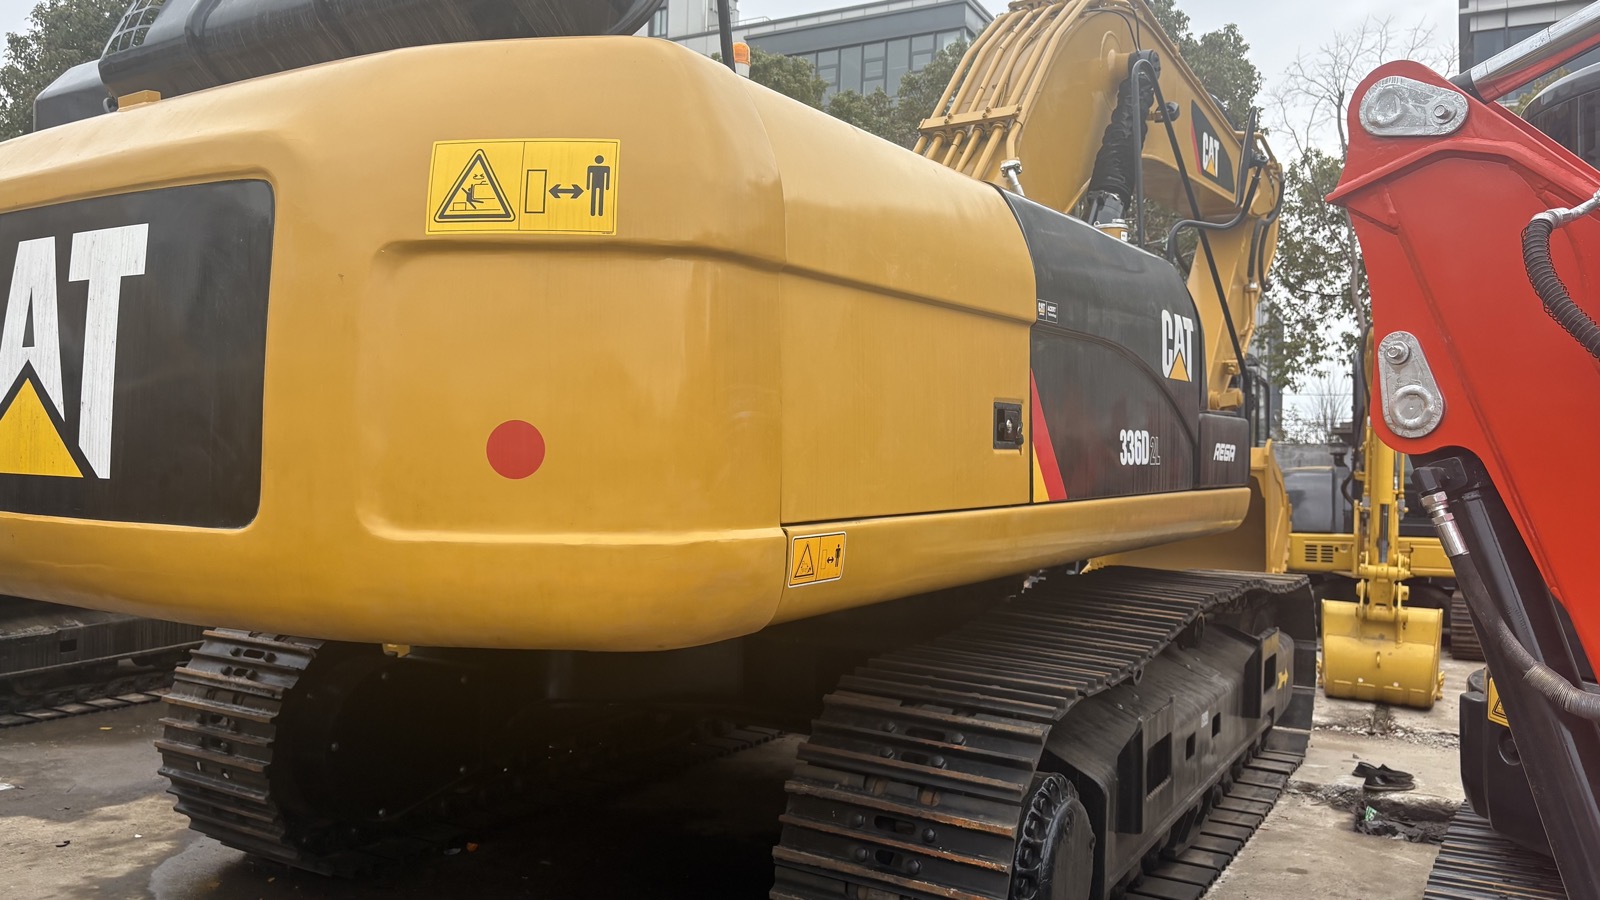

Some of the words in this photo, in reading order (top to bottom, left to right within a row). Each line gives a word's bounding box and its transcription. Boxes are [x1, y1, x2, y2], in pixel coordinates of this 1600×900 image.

[1202, 132, 1220, 178] CAT
[0, 222, 149, 479] AT
[1161, 309, 1194, 382] CAT
